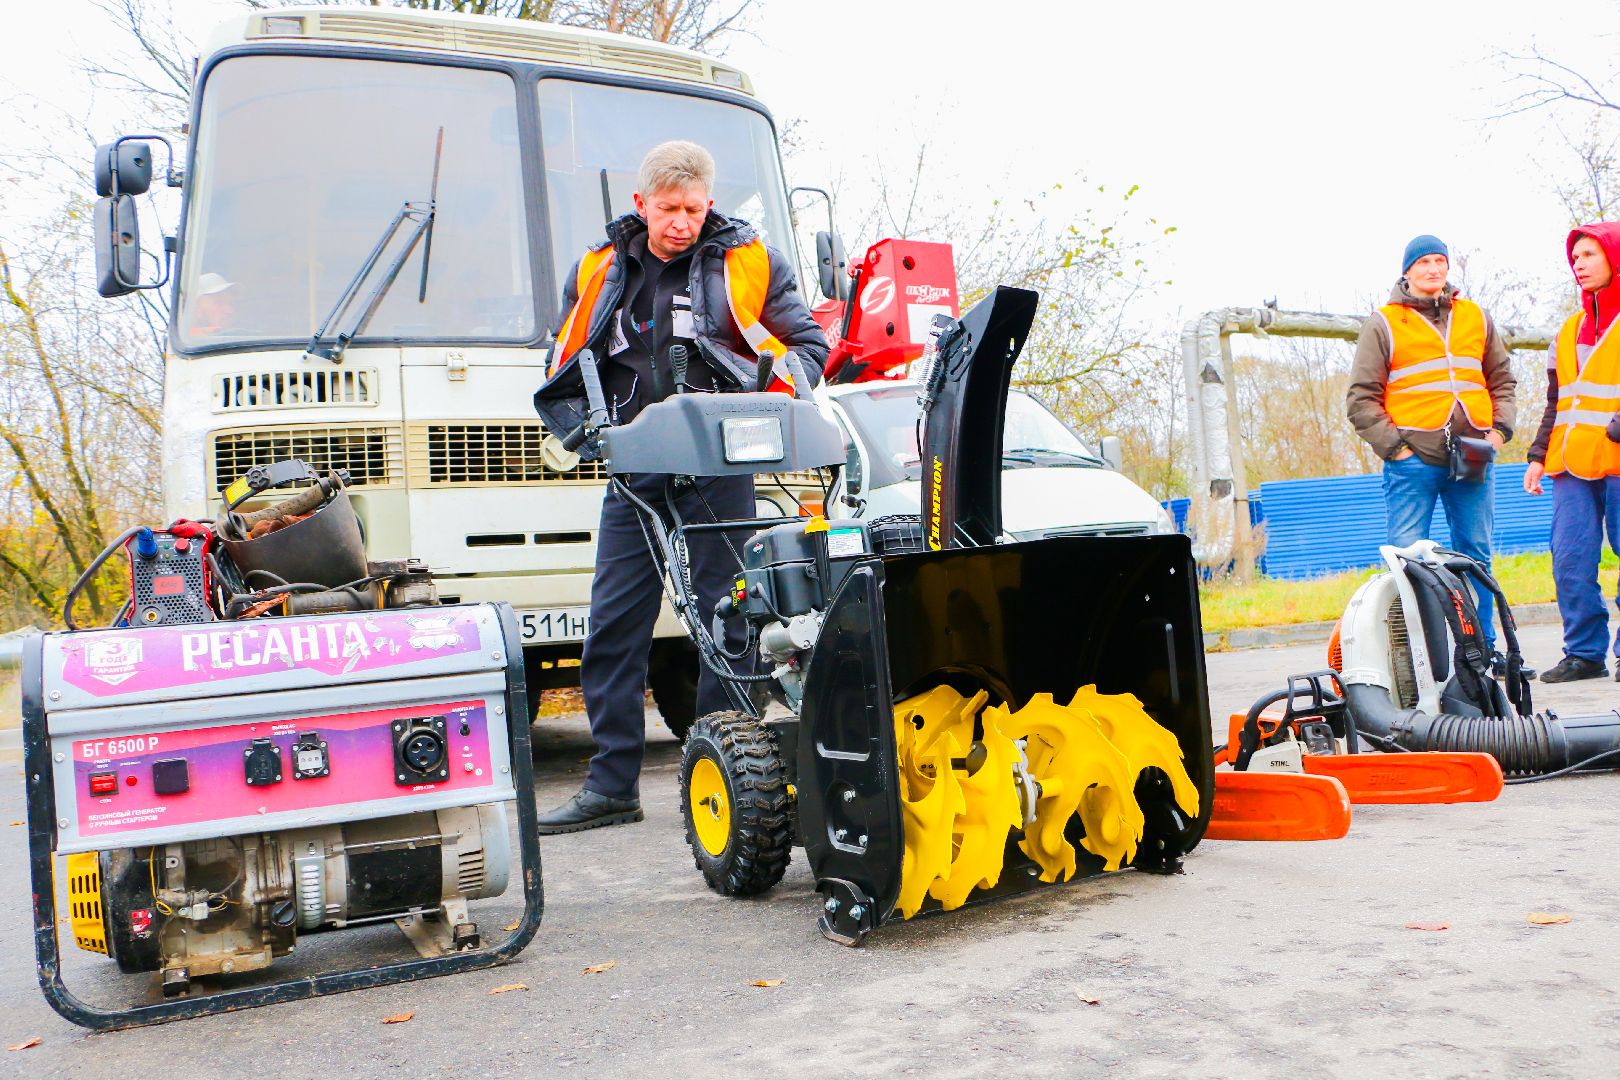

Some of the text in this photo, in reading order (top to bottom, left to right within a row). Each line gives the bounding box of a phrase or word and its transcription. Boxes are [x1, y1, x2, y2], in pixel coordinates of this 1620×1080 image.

[929, 458, 943, 551] CHAMPION
[517, 612, 592, 639] 511Н
[181, 621, 371, 672] РЕСАНТА
[82, 737, 159, 758] БГ 6500 Р
